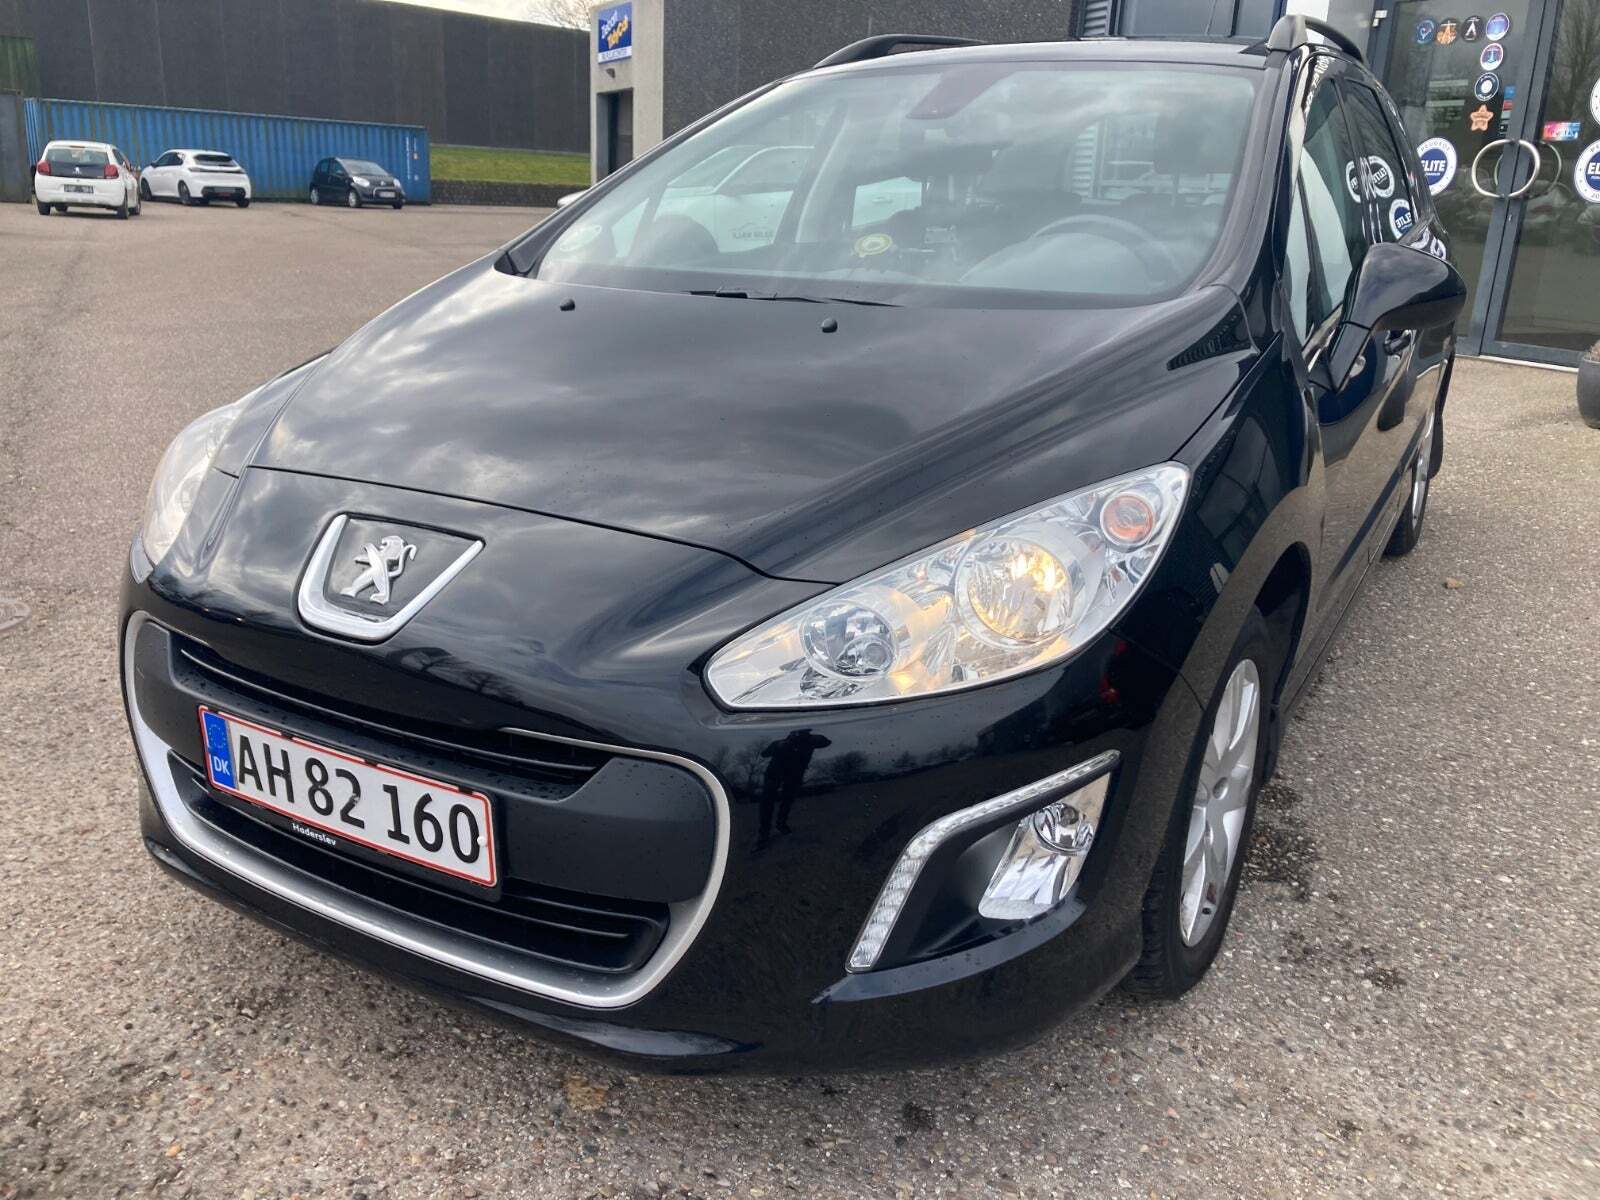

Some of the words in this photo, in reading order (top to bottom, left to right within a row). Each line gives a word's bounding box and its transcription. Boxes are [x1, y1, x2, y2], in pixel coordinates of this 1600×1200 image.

[213, 756, 231, 777] DK
[238, 734, 295, 804] AH
[305, 756, 365, 830] 82
[382, 783, 481, 864] 160
[291, 822, 337, 846] Haderslev
